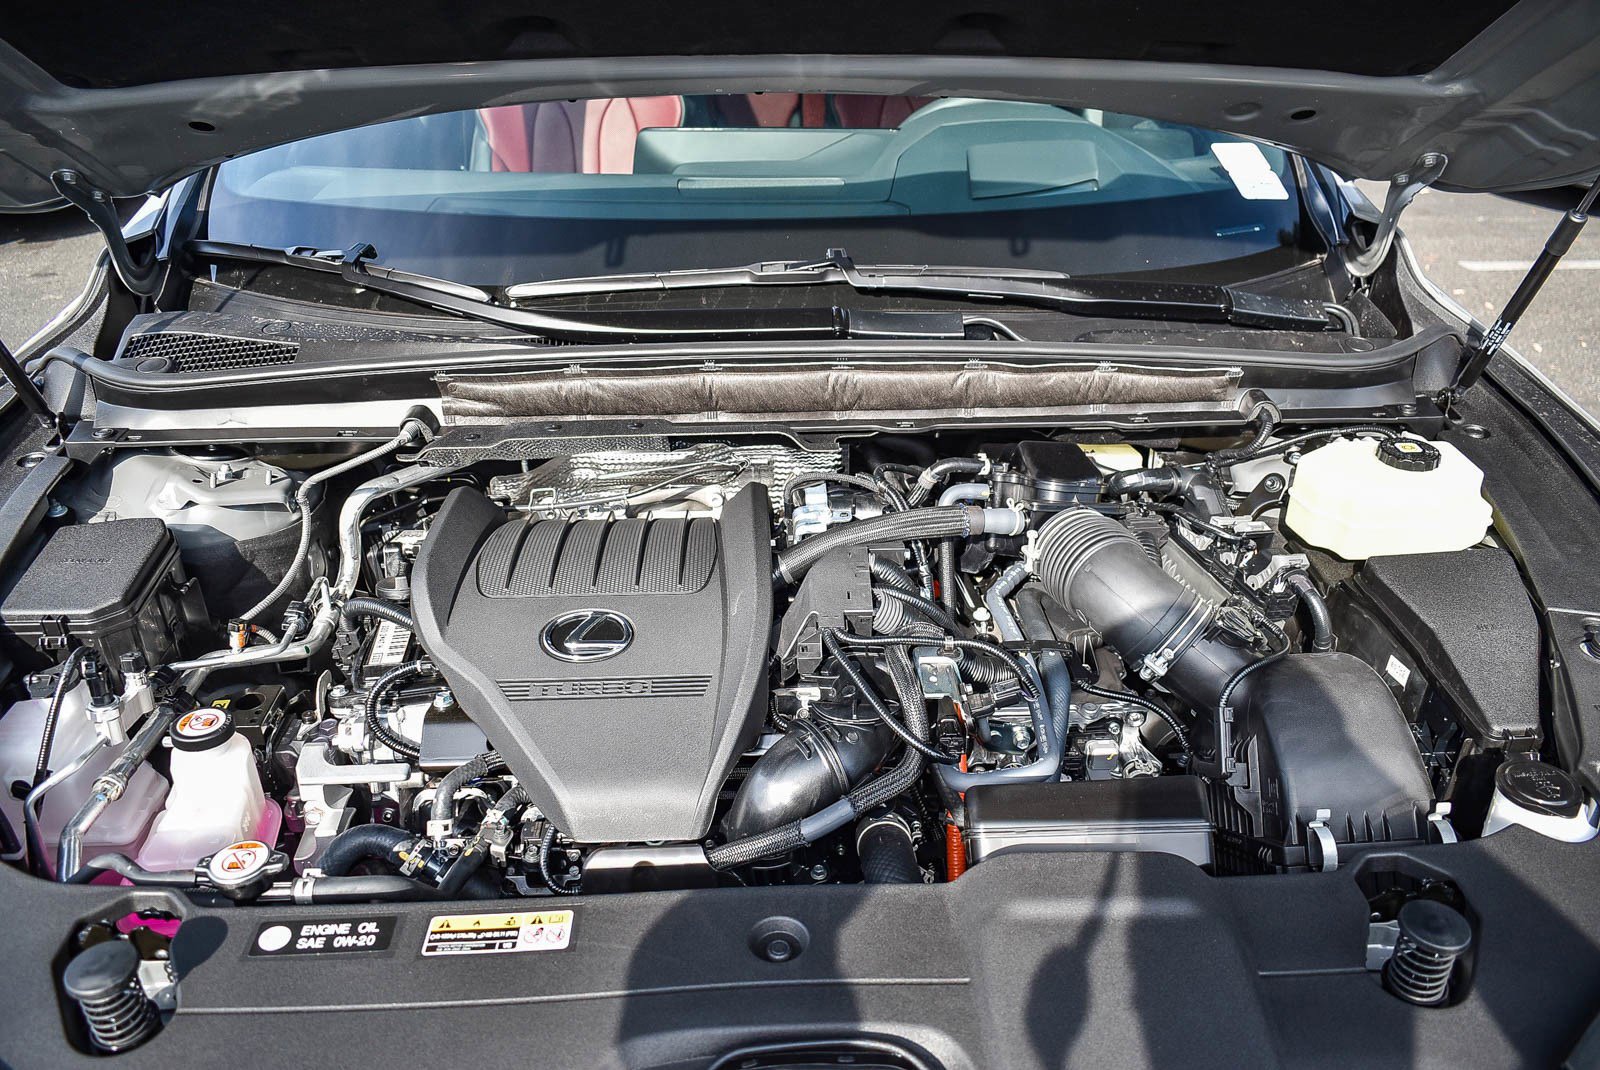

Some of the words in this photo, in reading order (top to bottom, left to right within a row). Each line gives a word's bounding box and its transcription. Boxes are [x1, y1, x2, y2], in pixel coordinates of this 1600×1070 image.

[530, 680, 649, 697] TURBO
[300, 923, 352, 937] ENGINE
[357, 921, 380, 934] OIL
[295, 937, 327, 950] SAE
[332, 934, 376, 948] 0W-20
